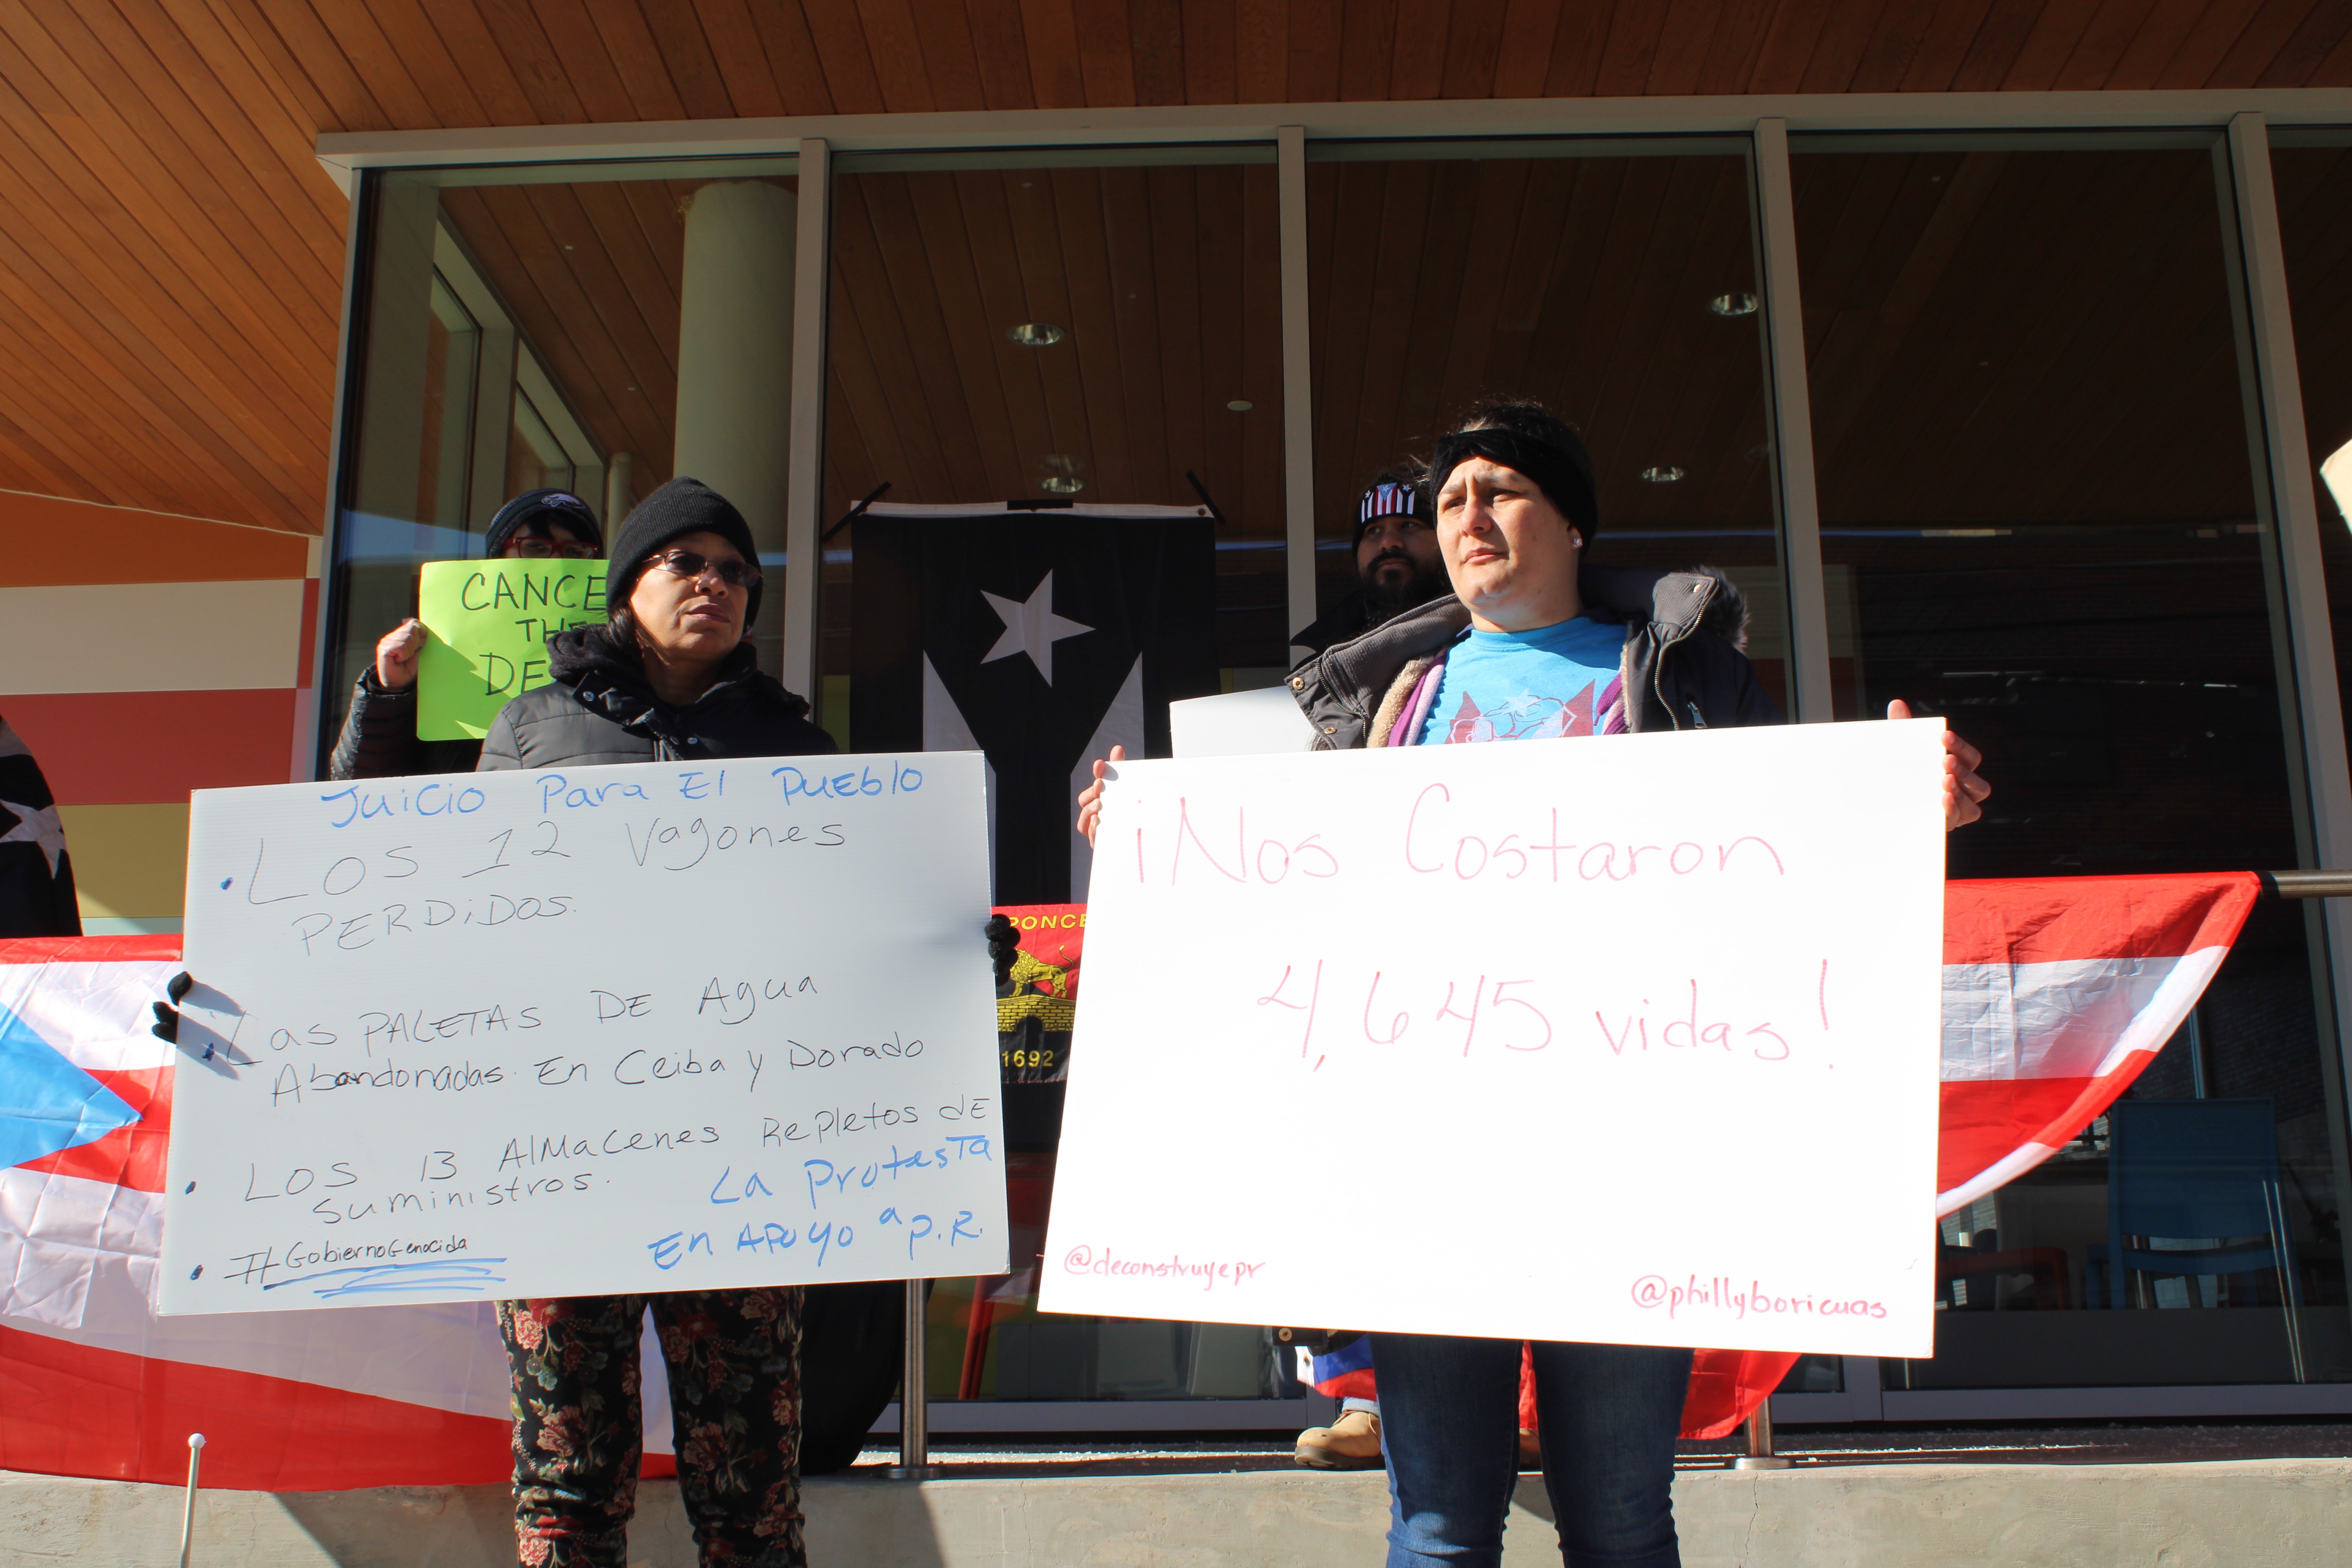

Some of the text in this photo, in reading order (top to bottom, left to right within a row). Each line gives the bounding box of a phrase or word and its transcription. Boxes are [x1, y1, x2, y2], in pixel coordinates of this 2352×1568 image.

[515, 618, 587, 644] TH
[537, 773, 649, 813] Para
[679, 769, 725, 800] El
[1406, 782, 1784, 882] Costaron
[249, 817, 845, 904] LOS 12 Vagones
[359, 1004, 542, 1057] PALETAS
[590, 989, 653, 1024] DE
[698, 976, 818, 1025] Agua
[1256, 959, 1552, 1072] 4,645
[534, 1056, 588, 1085] En
[615, 1048, 726, 1085] Ceiba
[787, 1031, 924, 1071] Dorado
[1002, 1050, 1053, 1067] 1692
[245, 1162, 358, 1202] LOS
[420, 1151, 457, 1182] 13
[710, 1166, 773, 1204] La
[647, 1231, 713, 1269] En
[1063, 1245, 1266, 1291] @deconstruyepr
[1631, 1274, 1887, 1320] @phillyboricuas
